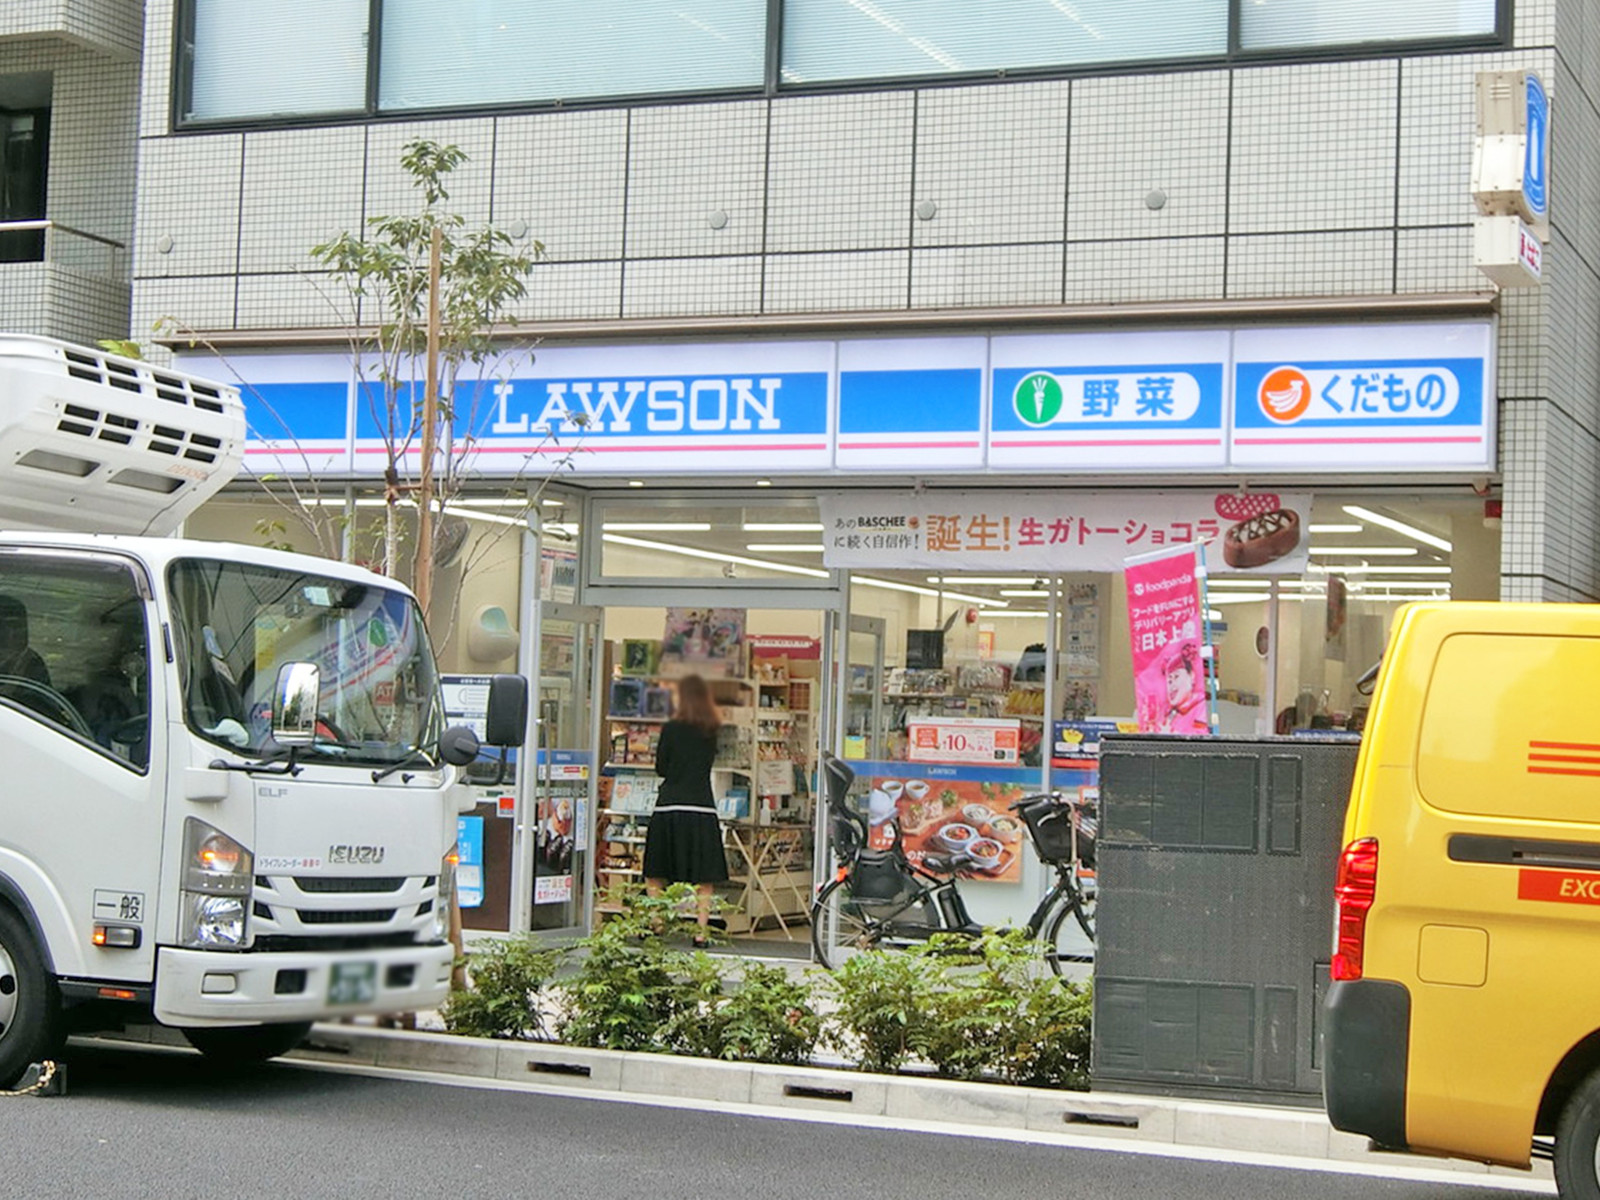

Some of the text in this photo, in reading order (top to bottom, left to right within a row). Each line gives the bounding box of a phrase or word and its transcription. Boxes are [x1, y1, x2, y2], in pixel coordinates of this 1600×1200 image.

[493, 378, 782, 434] LAWSON
[1082, 376, 1175, 417] 野菜
[1320, 373, 1447, 414] くだもの
[1145, 574, 1192, 592] foodpanda
[258, 787, 288, 798] ELF
[328, 845, 384, 864] ISUZU
[97, 894, 140, 920] 一般
